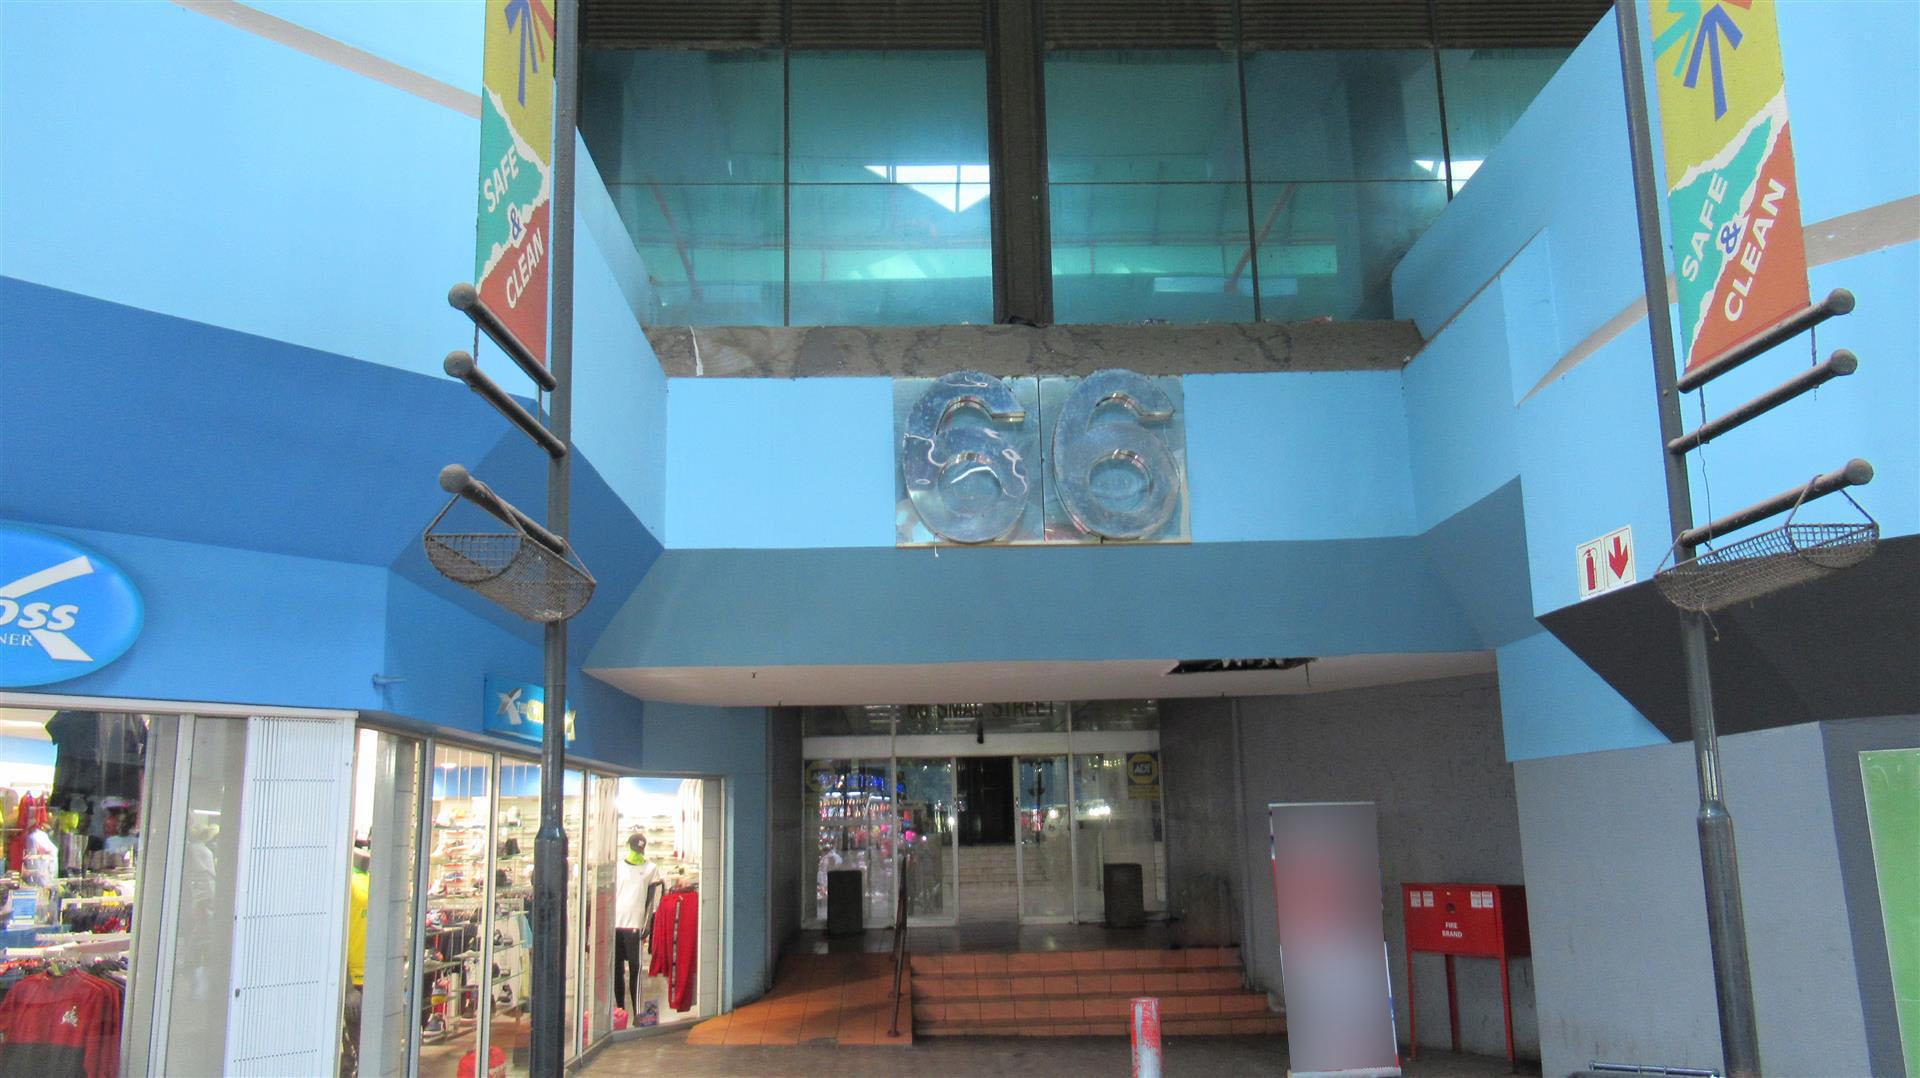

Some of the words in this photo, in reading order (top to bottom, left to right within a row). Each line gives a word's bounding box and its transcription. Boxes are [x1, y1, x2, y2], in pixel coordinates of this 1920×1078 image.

[483, 145, 520, 212] SAFE
[509, 208, 522, 241] &
[1682, 172, 1728, 282] SAFE
[1720, 222, 1741, 254] &
[1724, 178, 1786, 322] CLEAN
[506, 228, 544, 309] CLEAN
[902, 369, 1180, 544] 66
[1441, 930, 1463, 938] BRAND
